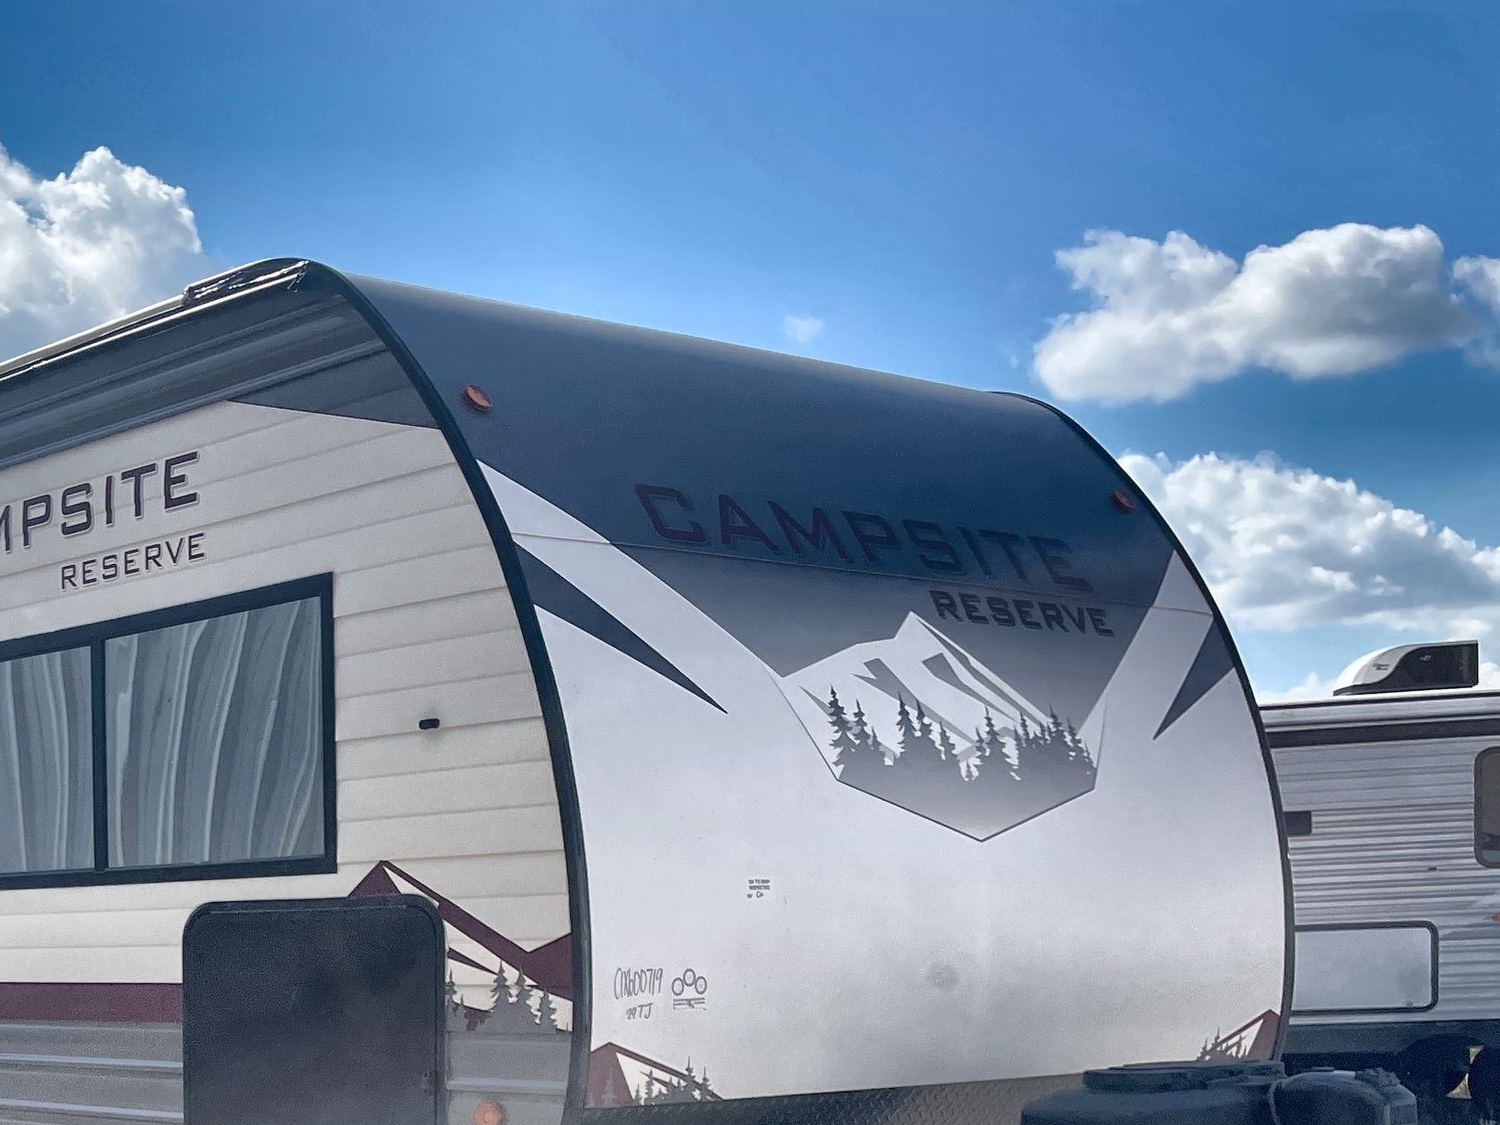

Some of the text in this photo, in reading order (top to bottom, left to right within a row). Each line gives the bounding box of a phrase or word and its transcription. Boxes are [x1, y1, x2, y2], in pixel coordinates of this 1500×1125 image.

[61, 533, 206, 590] RESERVE
[634, 483, 1093, 591] CAMPSITE
[929, 590, 1115, 638] RESERVE
